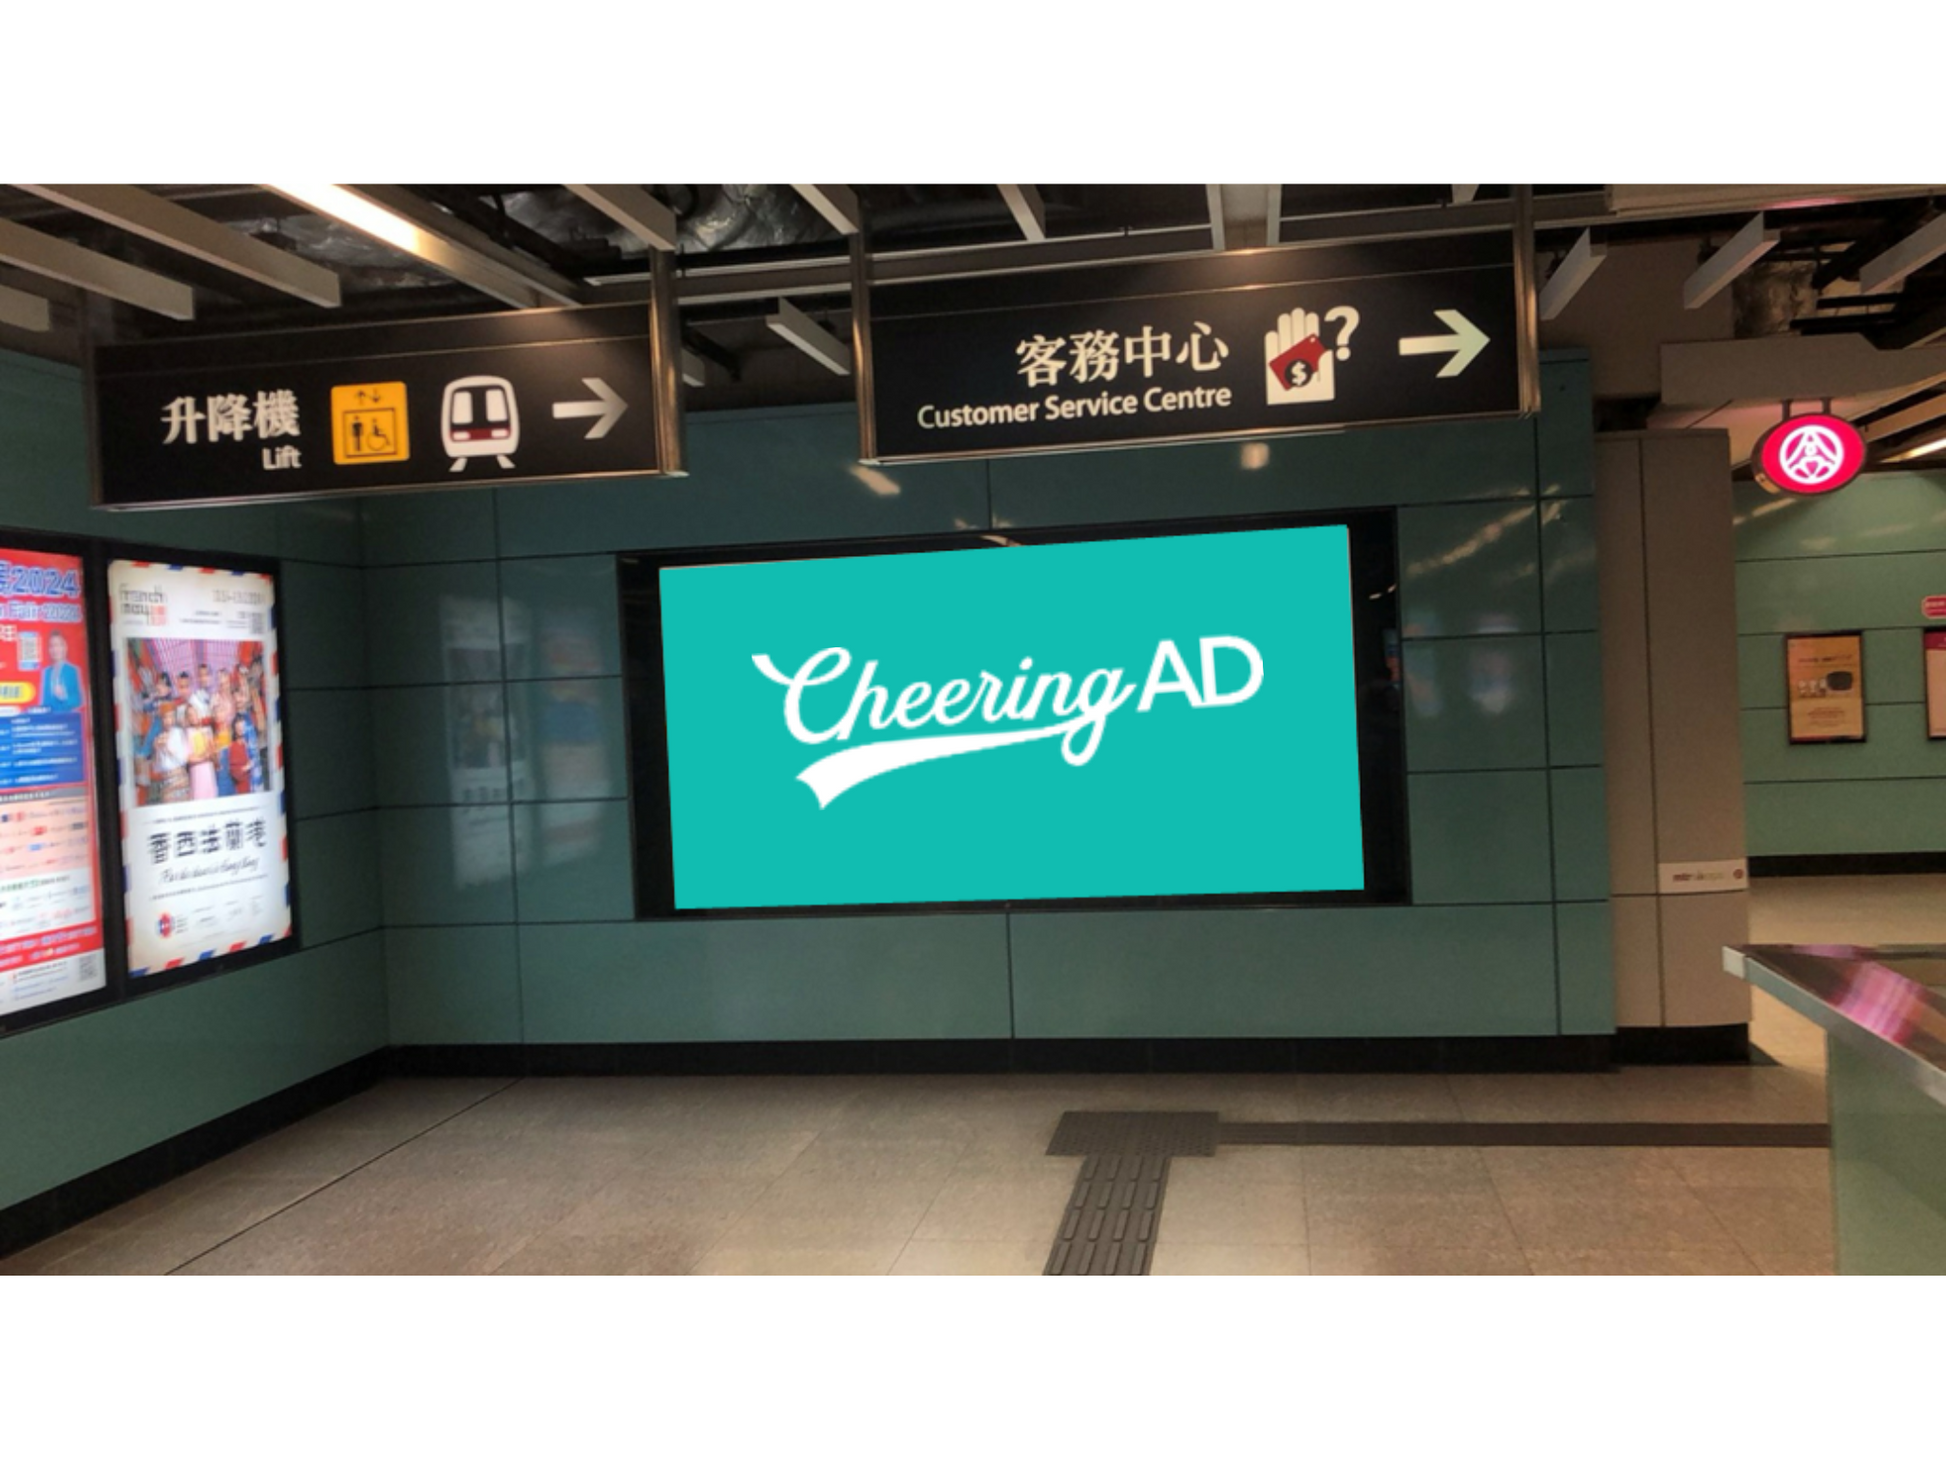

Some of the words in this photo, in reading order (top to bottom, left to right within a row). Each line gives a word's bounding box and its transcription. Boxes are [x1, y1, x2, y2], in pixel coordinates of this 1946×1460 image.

[1016, 321, 1229, 388] 客務中心
[160, 389, 301, 444] 升降機
[917, 398, 1038, 429] Customer
[1045, 390, 1137, 420] Service
[1144, 384, 1232, 413] Centre
[262, 445, 302, 470] Lift
